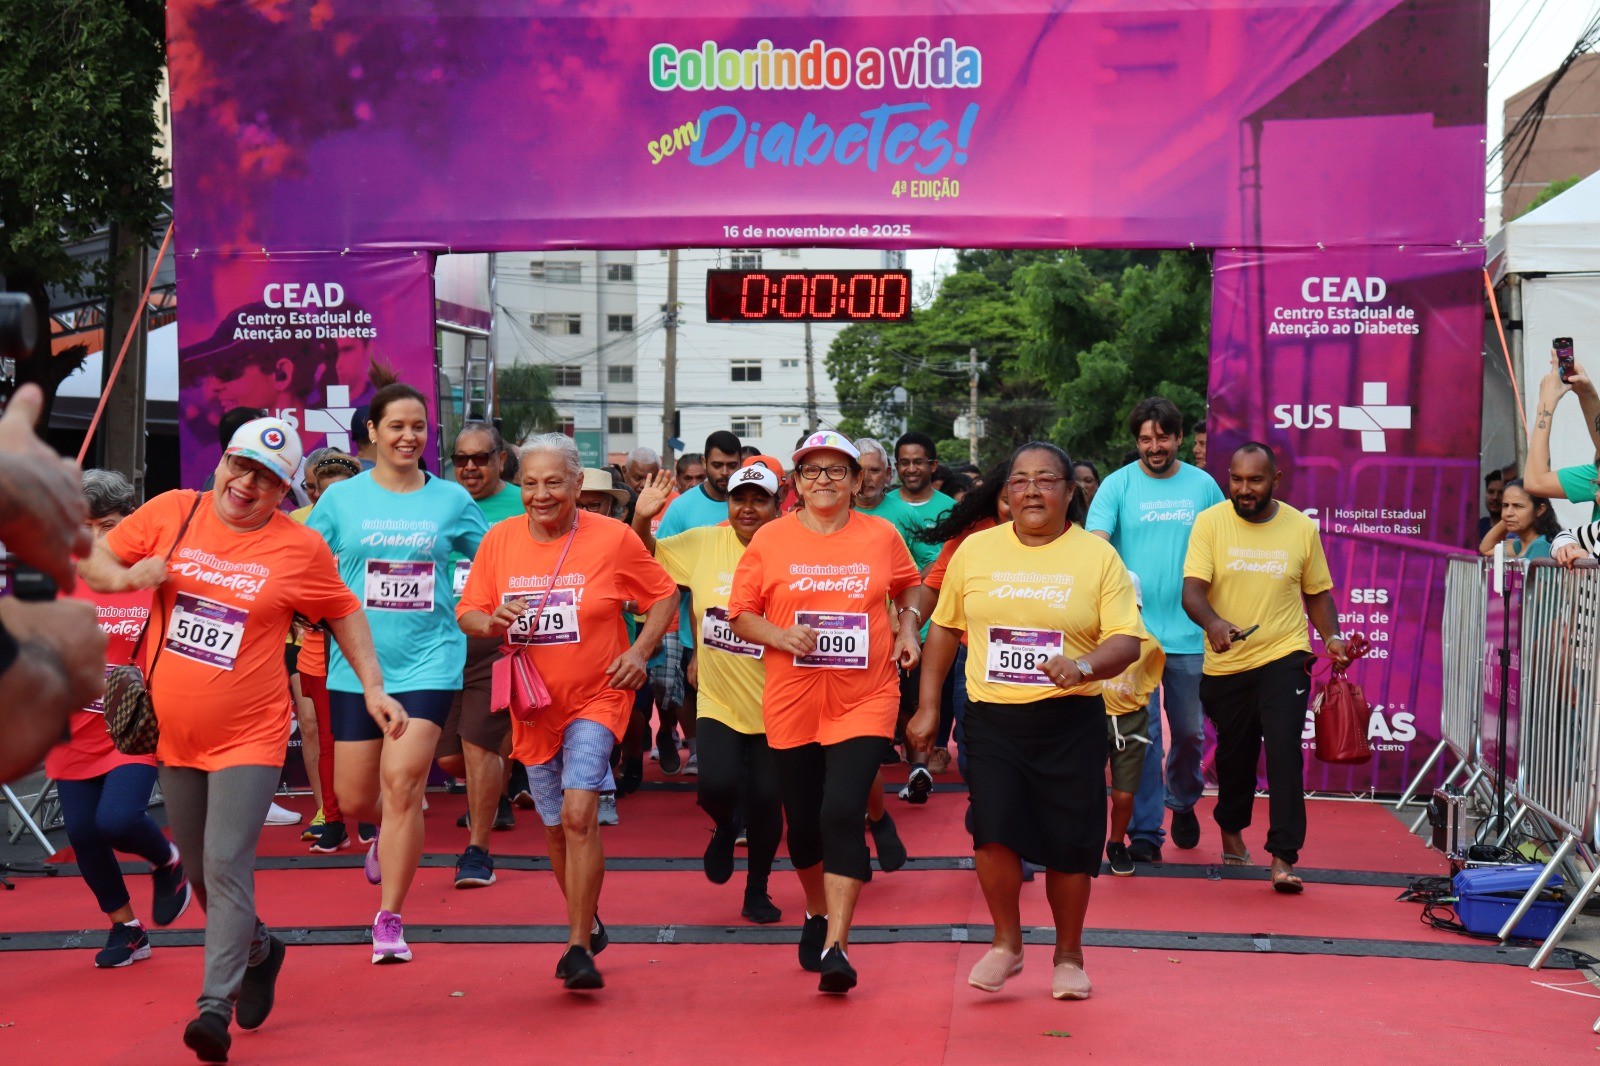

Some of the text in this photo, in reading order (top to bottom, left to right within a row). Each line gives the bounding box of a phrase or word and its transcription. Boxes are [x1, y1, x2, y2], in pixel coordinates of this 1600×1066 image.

[649, 37, 982, 90] Colorindo a vida
[647, 102, 979, 175] sem Diabetes!
[891, 177, 960, 201] 4ª EDIÇÃO
[723, 224, 912, 238] 16 de novembro de 2025
[263, 282, 345, 309] CEAD
[741, 274, 907, 317] 0:00:00
[1301, 276, 1387, 303] CEAD
[238, 310, 372, 326] Centro Estadual de
[1274, 305, 1415, 320] Centro Estadual de
[233, 325, 377, 343] Atenção ao Diabetes
[1268, 320, 1420, 338] Atenção ao Diabetes
[1273, 404, 1333, 429] SUS
[1147, 509, 1194, 522] Diabetes!
[1335, 509, 1426, 520] Hospital Estadual
[1335, 523, 1421, 534] Dr. Alberto Rassi
[368, 531, 438, 549] Diabetes!
[179, 547, 235, 572] Colorindo
[243, 562, 270, 577] vida
[789, 563, 870, 575] Colorindo a vida
[1233, 559, 1288, 575] Diabetes!
[180, 561, 266, 594] Diabetes!
[562, 572, 586, 586] vida
[798, 576, 870, 593] Diabetes!
[991, 571, 1075, 586] Colorindo a vida
[381, 581, 420, 598] 5124
[997, 584, 1072, 603] Diabetes!
[1350, 588, 1389, 604] SES
[118, 607, 127, 618] a
[127, 606, 149, 618] vida
[1369, 611, 1389, 624] de
[517, 613, 564, 632] 5079
[176, 619, 234, 651] 5087
[713, 625, 750, 645] 50
[815, 635, 856, 653] 090
[1369, 629, 1389, 642] da
[1301, 704, 1417, 742] GÁS
[1377, 744, 1406, 752] CERTO
